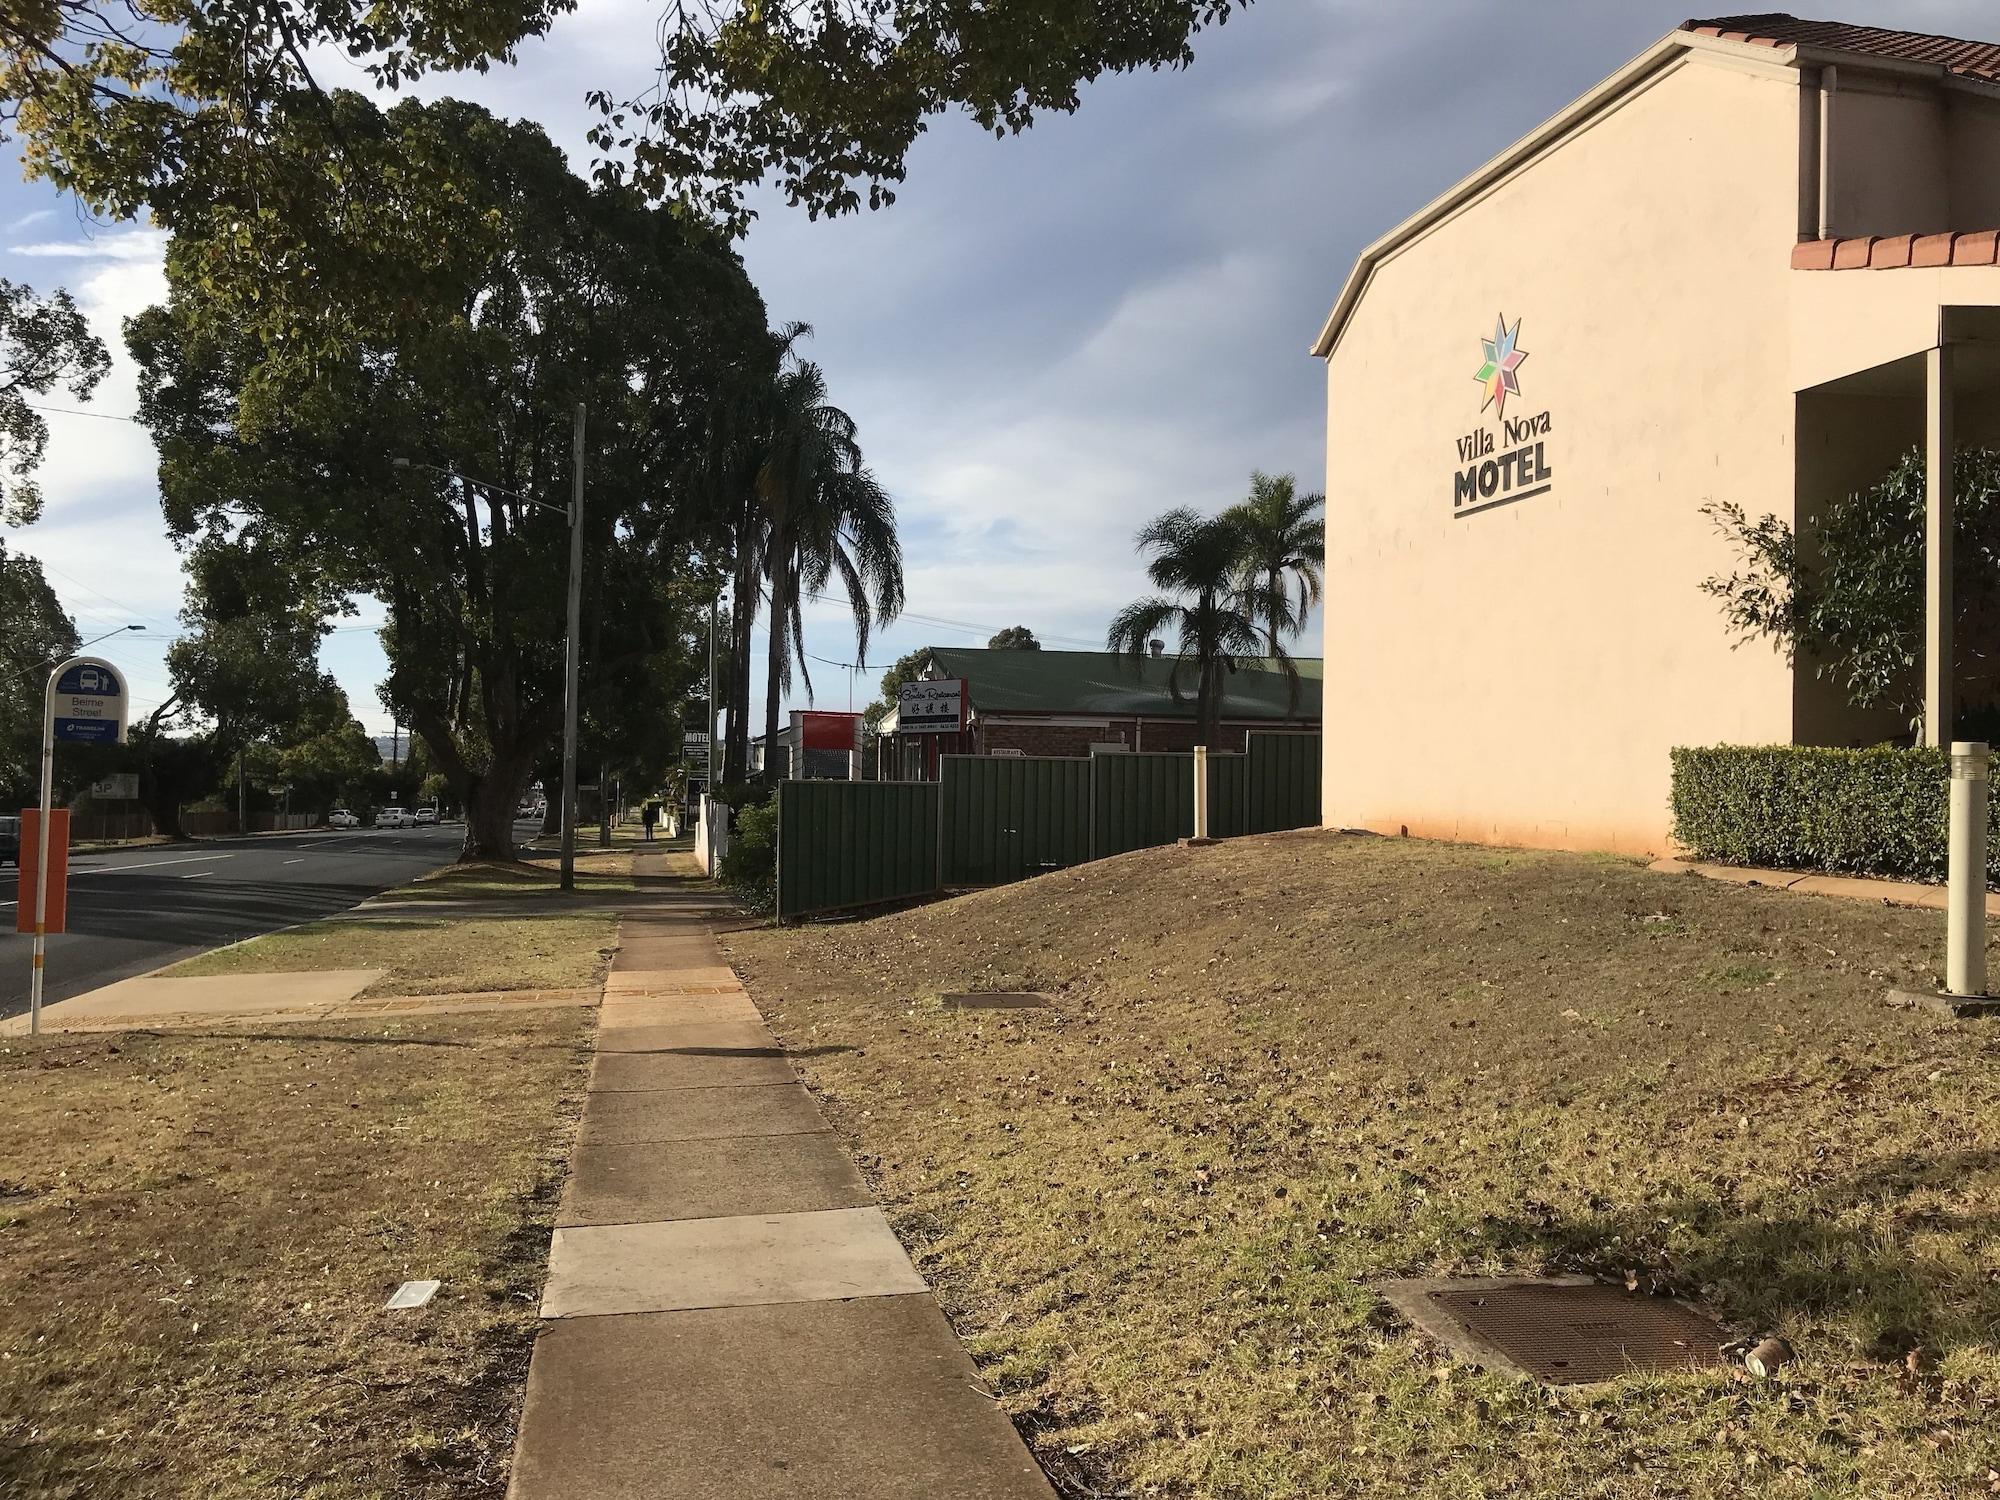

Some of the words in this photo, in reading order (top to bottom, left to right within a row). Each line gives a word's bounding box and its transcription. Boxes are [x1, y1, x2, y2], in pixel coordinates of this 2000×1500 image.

[1456, 427, 1495, 463] Villa
[1503, 410, 1552, 448] Nova
[1454, 441, 1552, 507] MOTEL
[72, 697, 104, 706] Beirne
[72, 707, 102, 717] Street
[685, 732, 709, 743] MOTEL
